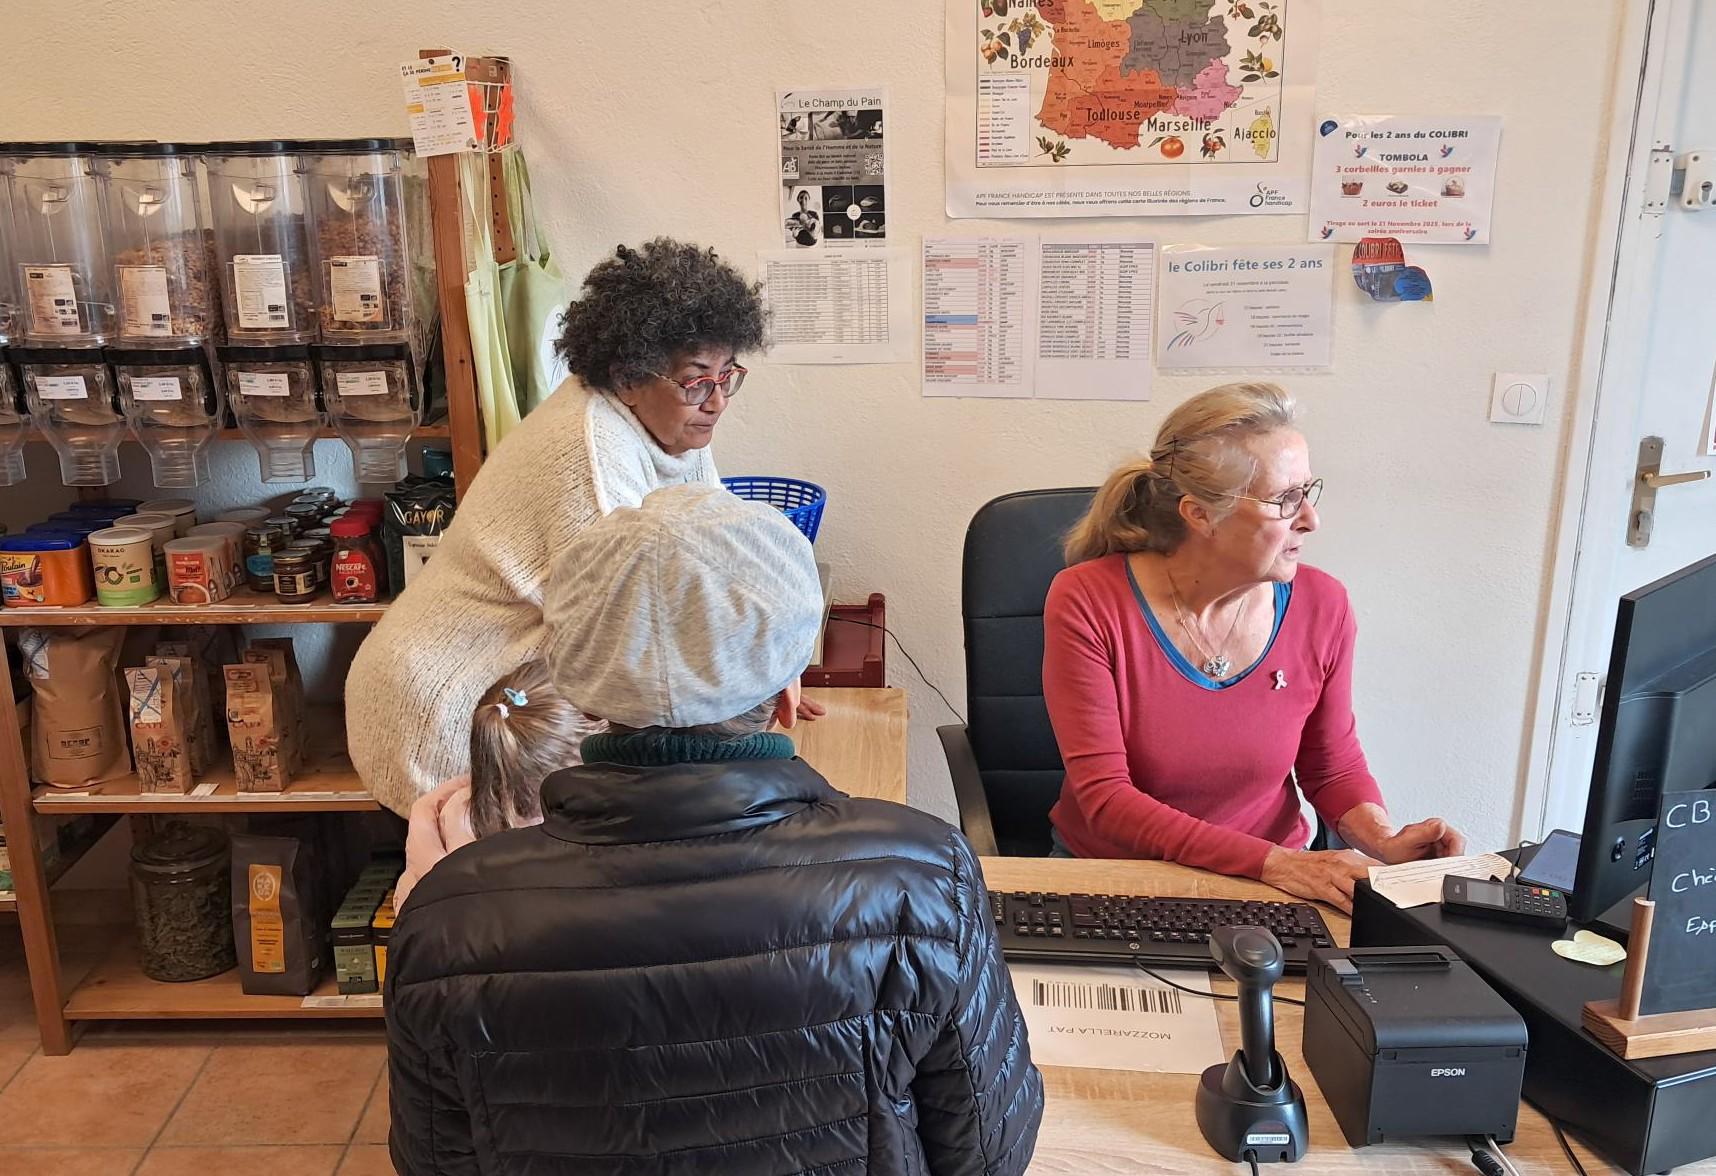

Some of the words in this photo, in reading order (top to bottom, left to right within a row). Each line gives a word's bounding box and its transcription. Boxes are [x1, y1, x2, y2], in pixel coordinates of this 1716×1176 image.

[1181, 29, 1208, 46] Lyon
[1010, 54, 1074, 69] Bordeaux
[799, 99, 810, 109] Le
[812, 97, 845, 109] Champ
[848, 96, 859, 107] du
[861, 96, 882, 106] Pain
[1087, 108, 1141, 121] Toulouse
[1147, 116, 1212, 132] Marseille
[1234, 127, 1277, 141] Ajaccio
[1370, 131, 1384, 139] les
[1386, 131, 1392, 139] 2
[1413, 131, 1426, 139] du
[1428, 130, 1469, 139] COLIBRI
[1379, 154, 1429, 162] TOMBOLA
[1344, 165, 1389, 174] corbeilles
[1391, 166, 1427, 176] garnies
[1437, 166, 1472, 176] gagner
[1410, 199, 1438, 207] ticket
[1168, 262, 1180, 272] le
[1184, 260, 1228, 272] Colibri
[1232, 259, 1260, 271] fête
[1263, 260, 1283, 270] ses
[1288, 258, 1296, 269] 2
[1300, 258, 1323, 269] ans
[1666, 800, 1711, 829] CB
[1671, 867, 1716, 893] Chè
[1080, 1027, 1172, 1041] MOZZARELLA
[1430, 1068, 1466, 1077] EPSON
